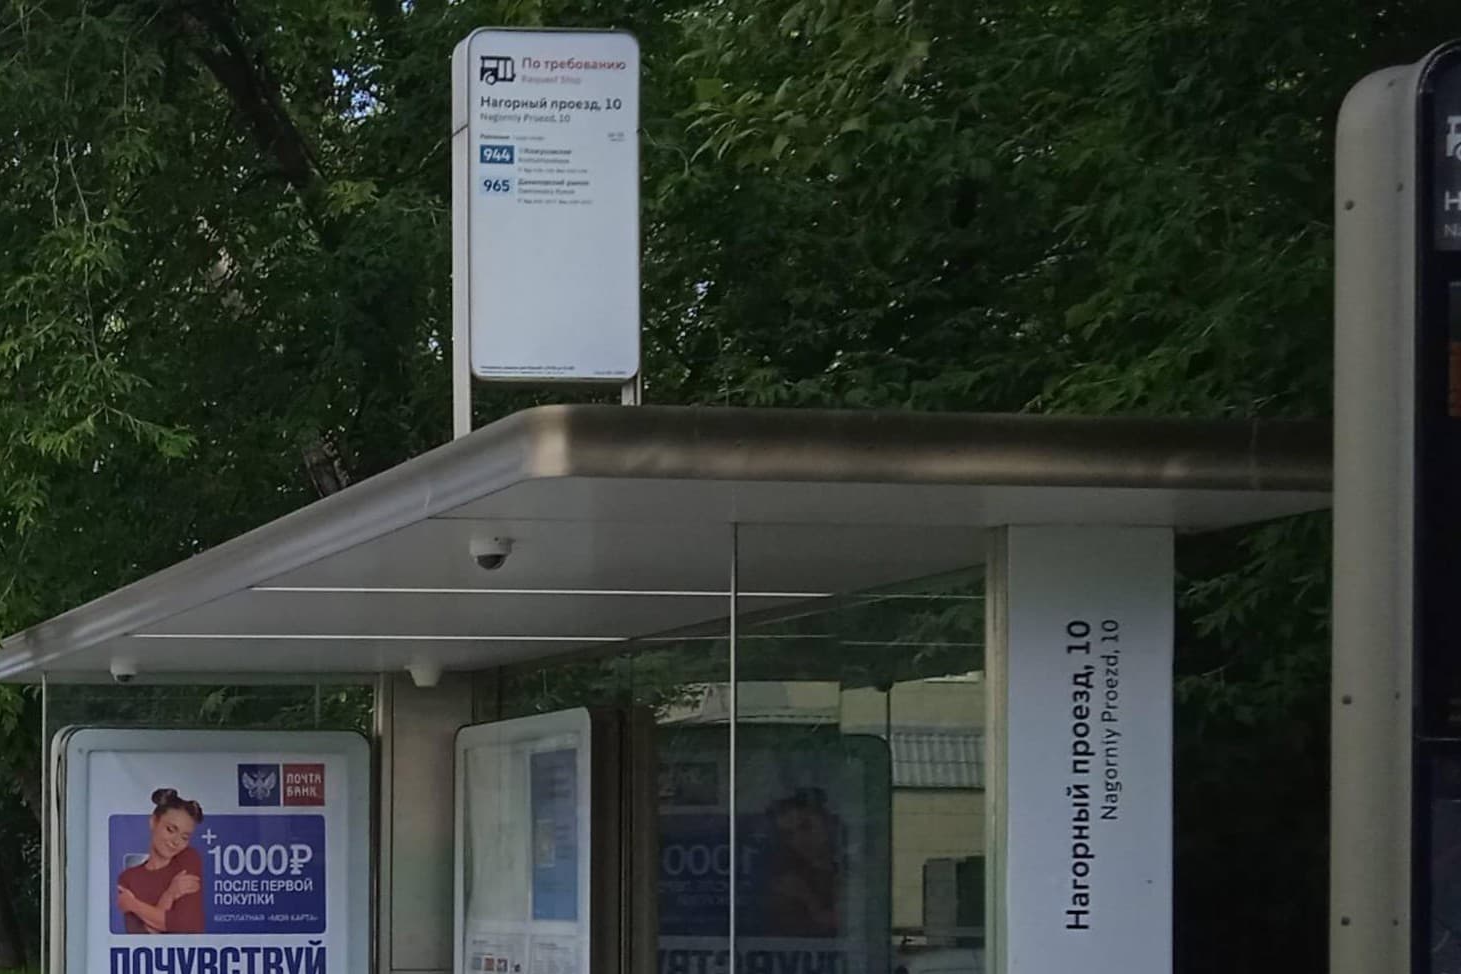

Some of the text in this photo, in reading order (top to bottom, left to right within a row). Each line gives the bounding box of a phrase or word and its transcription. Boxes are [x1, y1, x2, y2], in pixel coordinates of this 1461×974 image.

[522, 57, 627, 71] По требованию
[480, 95, 548, 110] Нагорный
[605, 98, 622, 110] 10
[559, 114, 571, 123] 10
[483, 148, 511, 161] 944
[483, 179, 510, 192] 965
[1100, 619, 1122, 821] Nagorniy Proezd, 10
[286, 773, 322, 784] ПОЧТА
[1066, 620, 1095, 930] Нагорный проезд, 10
[286, 786, 317, 797] БАНК
[214, 878, 313, 892] ПОСЛЕ ПЕРВОЙ
[214, 893, 275, 905] ПОКУПКИ
